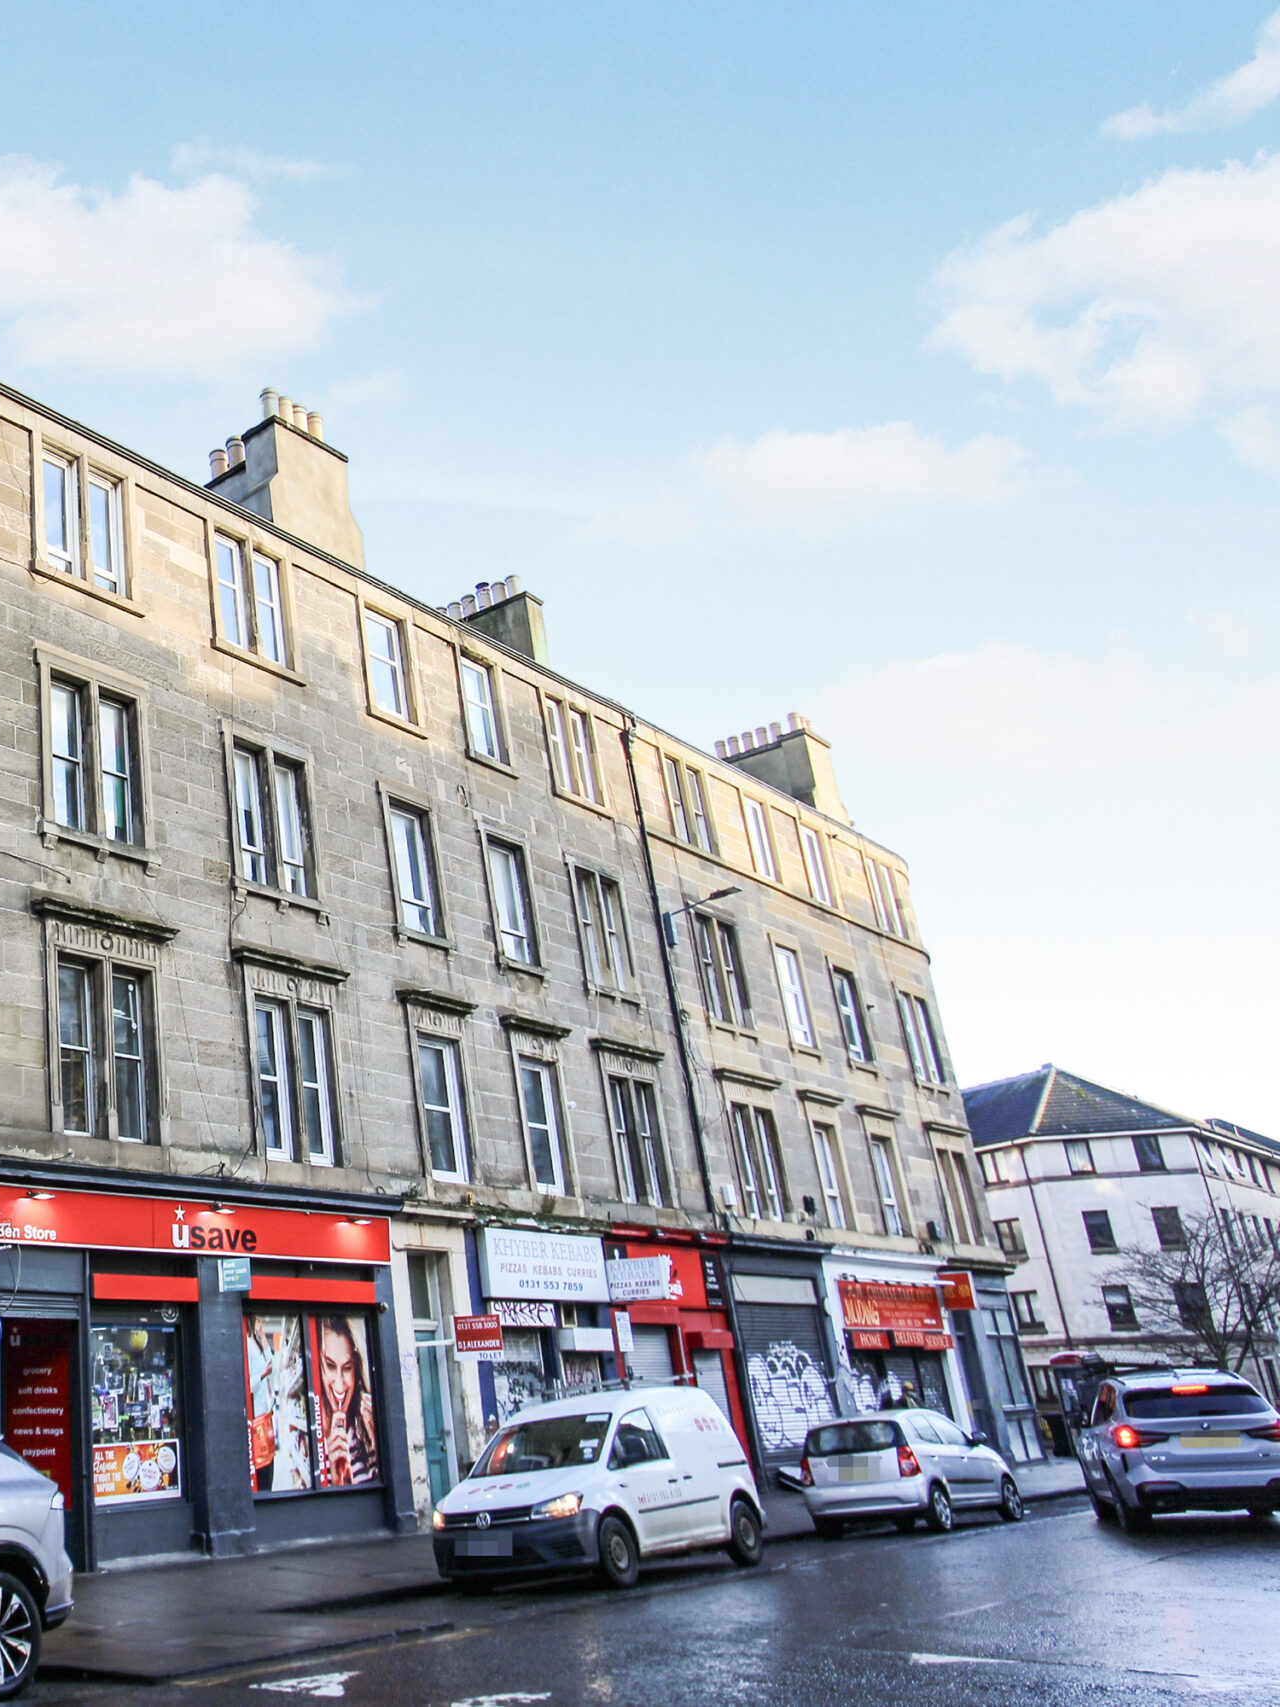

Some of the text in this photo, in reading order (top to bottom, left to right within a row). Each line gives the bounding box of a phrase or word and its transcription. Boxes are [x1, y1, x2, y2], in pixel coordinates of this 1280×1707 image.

[23, 1224, 57, 1241] Store
[171, 1223, 258, 1252] usave
[492, 1237, 599, 1263] KHYBER KEBABS
[500, 1262, 598, 1279] PIZZAS KEBABS CURRIES
[609, 1259, 655, 1271] KHYBER
[612, 1270, 656, 1281] KEBABS
[519, 1279, 584, 1292] 0131 553 7859
[610, 1279, 661, 1289] PIZZAS KEBABS
[622, 1288, 650, 1296] CURRIES
[457, 1322, 471, 1331] 0131
[859, 1330, 950, 1348] HOME DELIVERY SERVICE
[479, 1351, 502, 1360] TO LET
[23, 1367, 53, 1377] grocery
[18, 1386, 59, 1395] soft drinks
[12, 1406, 64, 1417] confectionery
[13, 1426, 64, 1438] news & mags
[22, 1447, 57, 1458] paypoint
